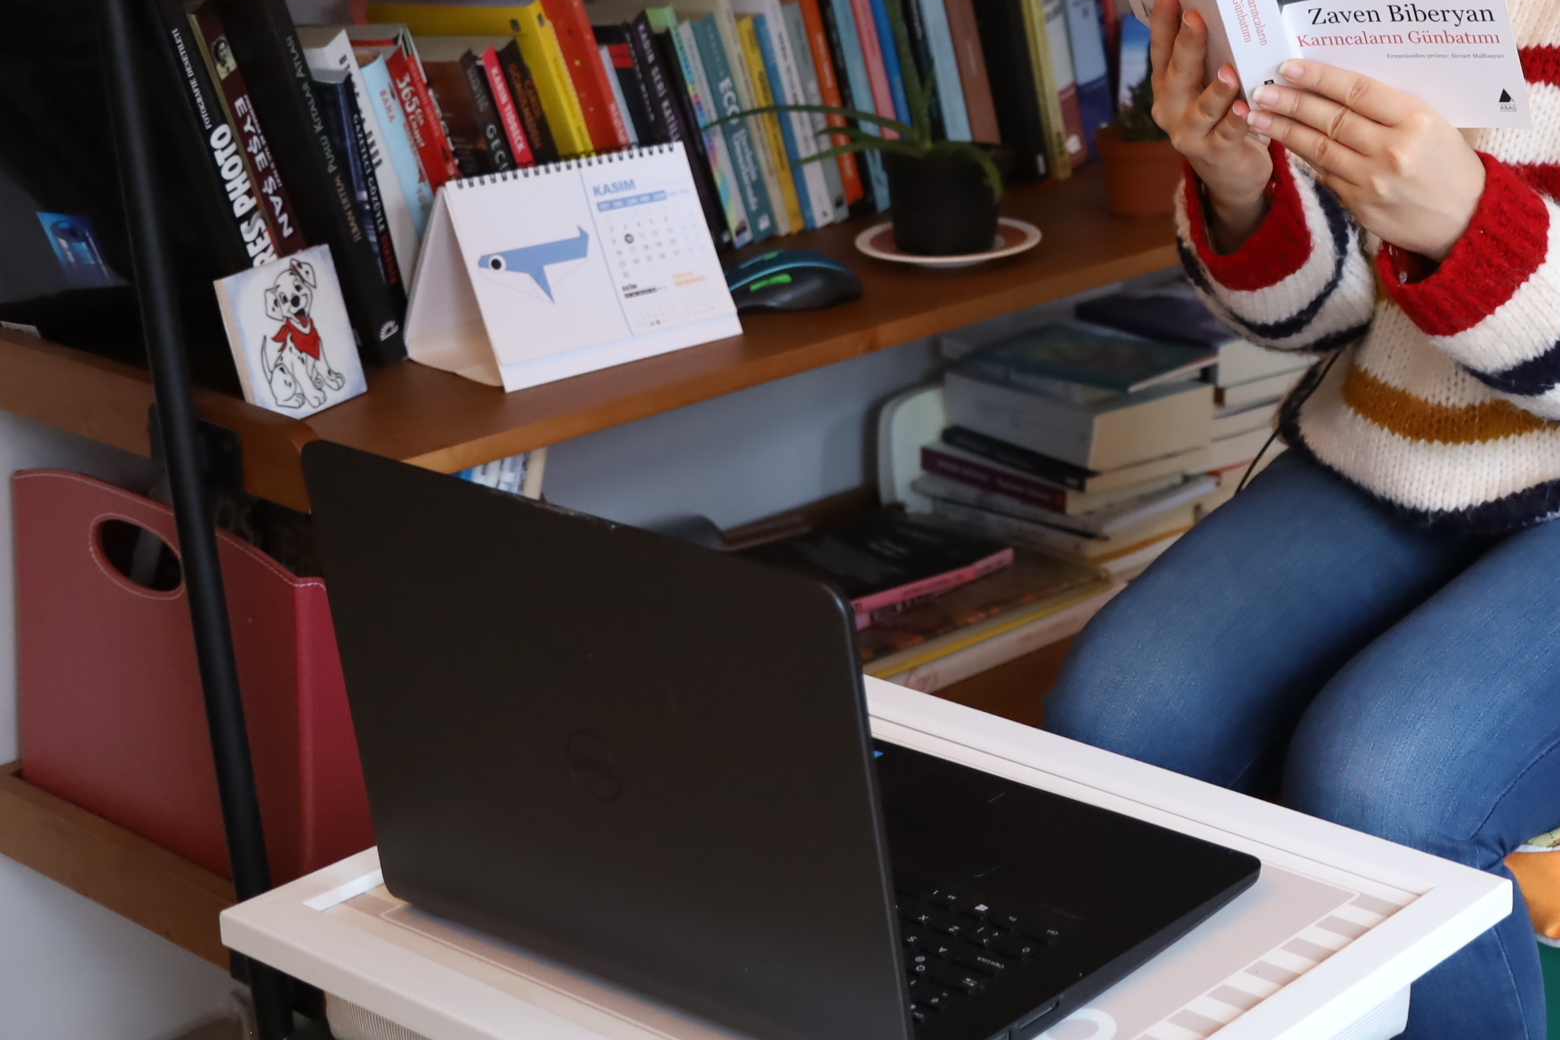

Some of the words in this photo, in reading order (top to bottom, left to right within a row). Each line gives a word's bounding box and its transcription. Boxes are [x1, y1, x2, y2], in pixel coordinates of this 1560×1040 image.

[1308, 7, 1382, 26] Zaven
[1386, 3, 1496, 27] Biberyan
[638, 21, 656, 64] KADIN
[1296, 30, 1404, 48] Karıncaların
[1408, 29, 1502, 45] Günbatımı
[1472, 52, 1505, 60] Malhasyan
[396, 72, 421, 114] 365
[490, 65, 509, 104] KARIN
[189, 79, 213, 131] FOTOGRAFIE
[210, 123, 257, 218] PHOTO
[233, 95, 269, 172] EYŞE
[262, 175, 294, 239] ŞAN
[593, 179, 636, 197] KASIM
